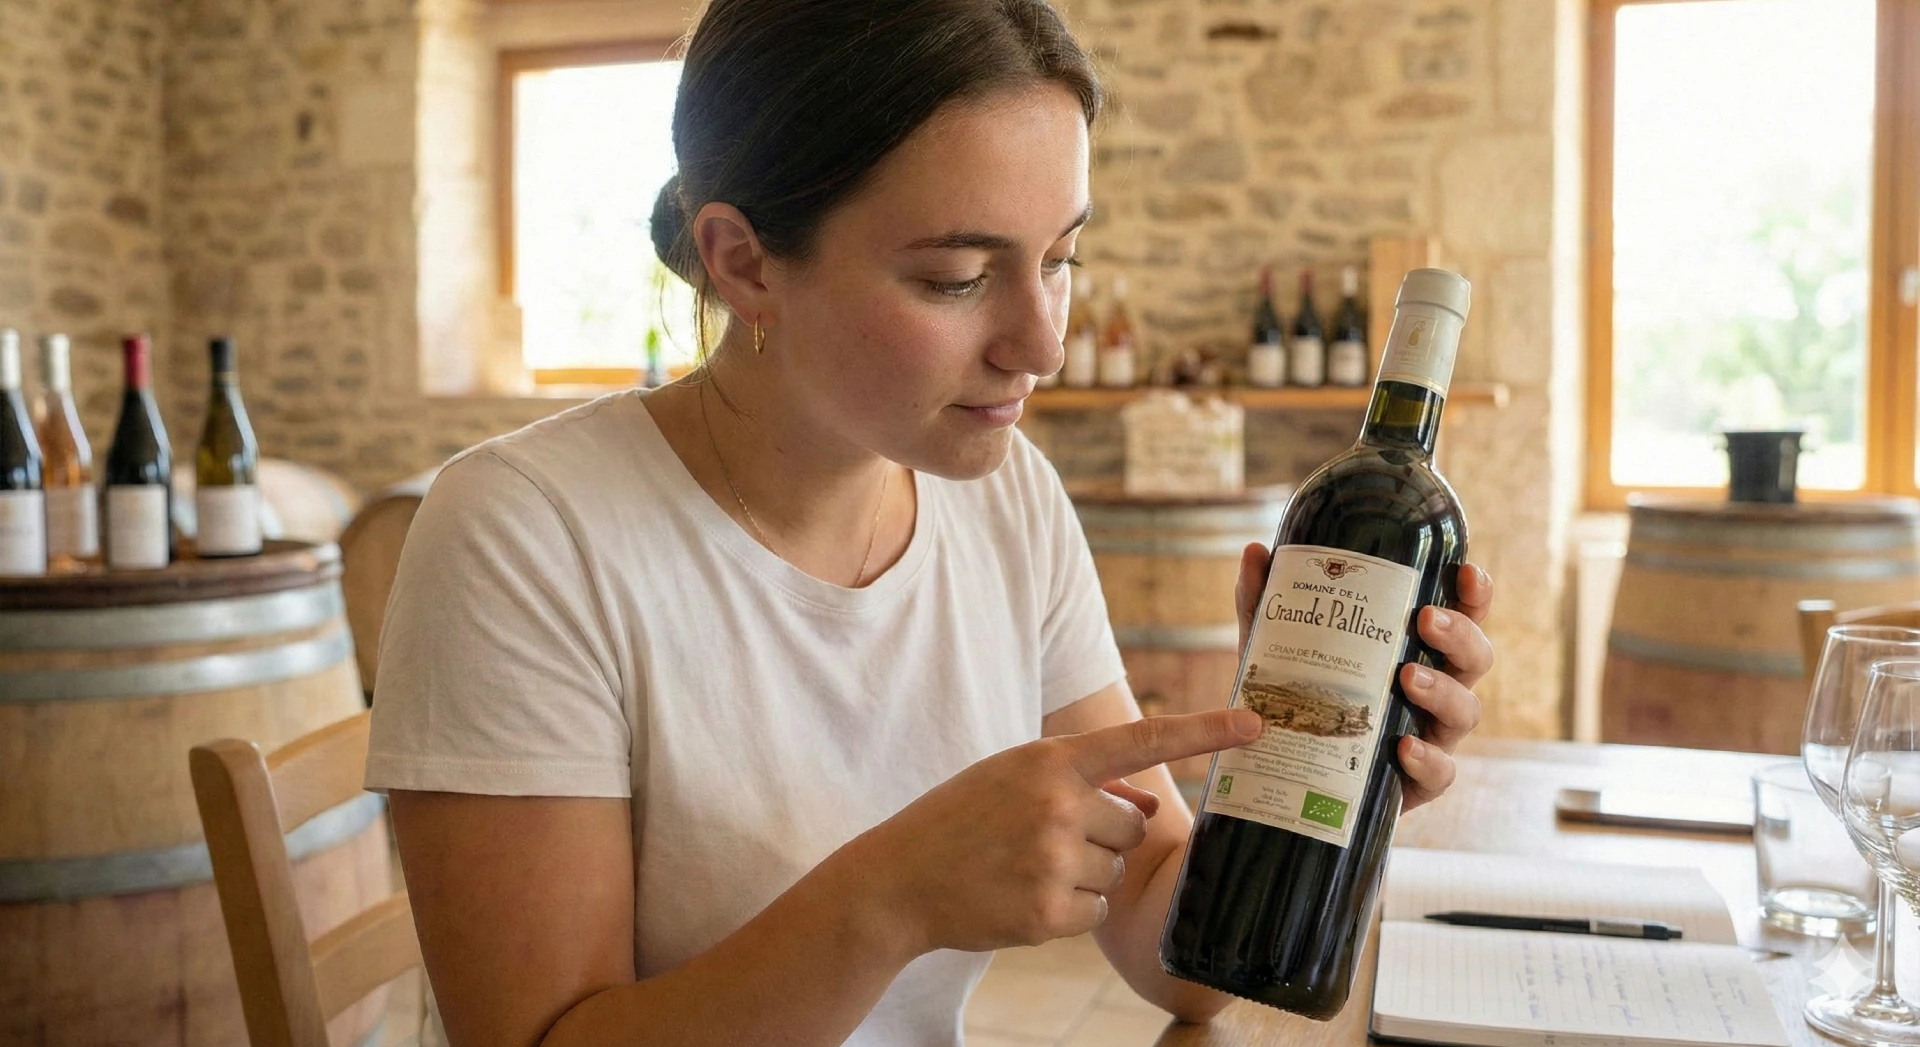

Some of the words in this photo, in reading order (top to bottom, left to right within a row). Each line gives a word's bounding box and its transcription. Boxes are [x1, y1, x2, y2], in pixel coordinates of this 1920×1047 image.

[1292, 581, 1337, 595] DOMAINE
[1339, 588, 1354, 599] DE
[1355, 592, 1369, 603] LA
[1265, 593, 1324, 626] Grande
[1326, 599, 1393, 644] Pallière
[1296, 648, 1310, 658] DE
